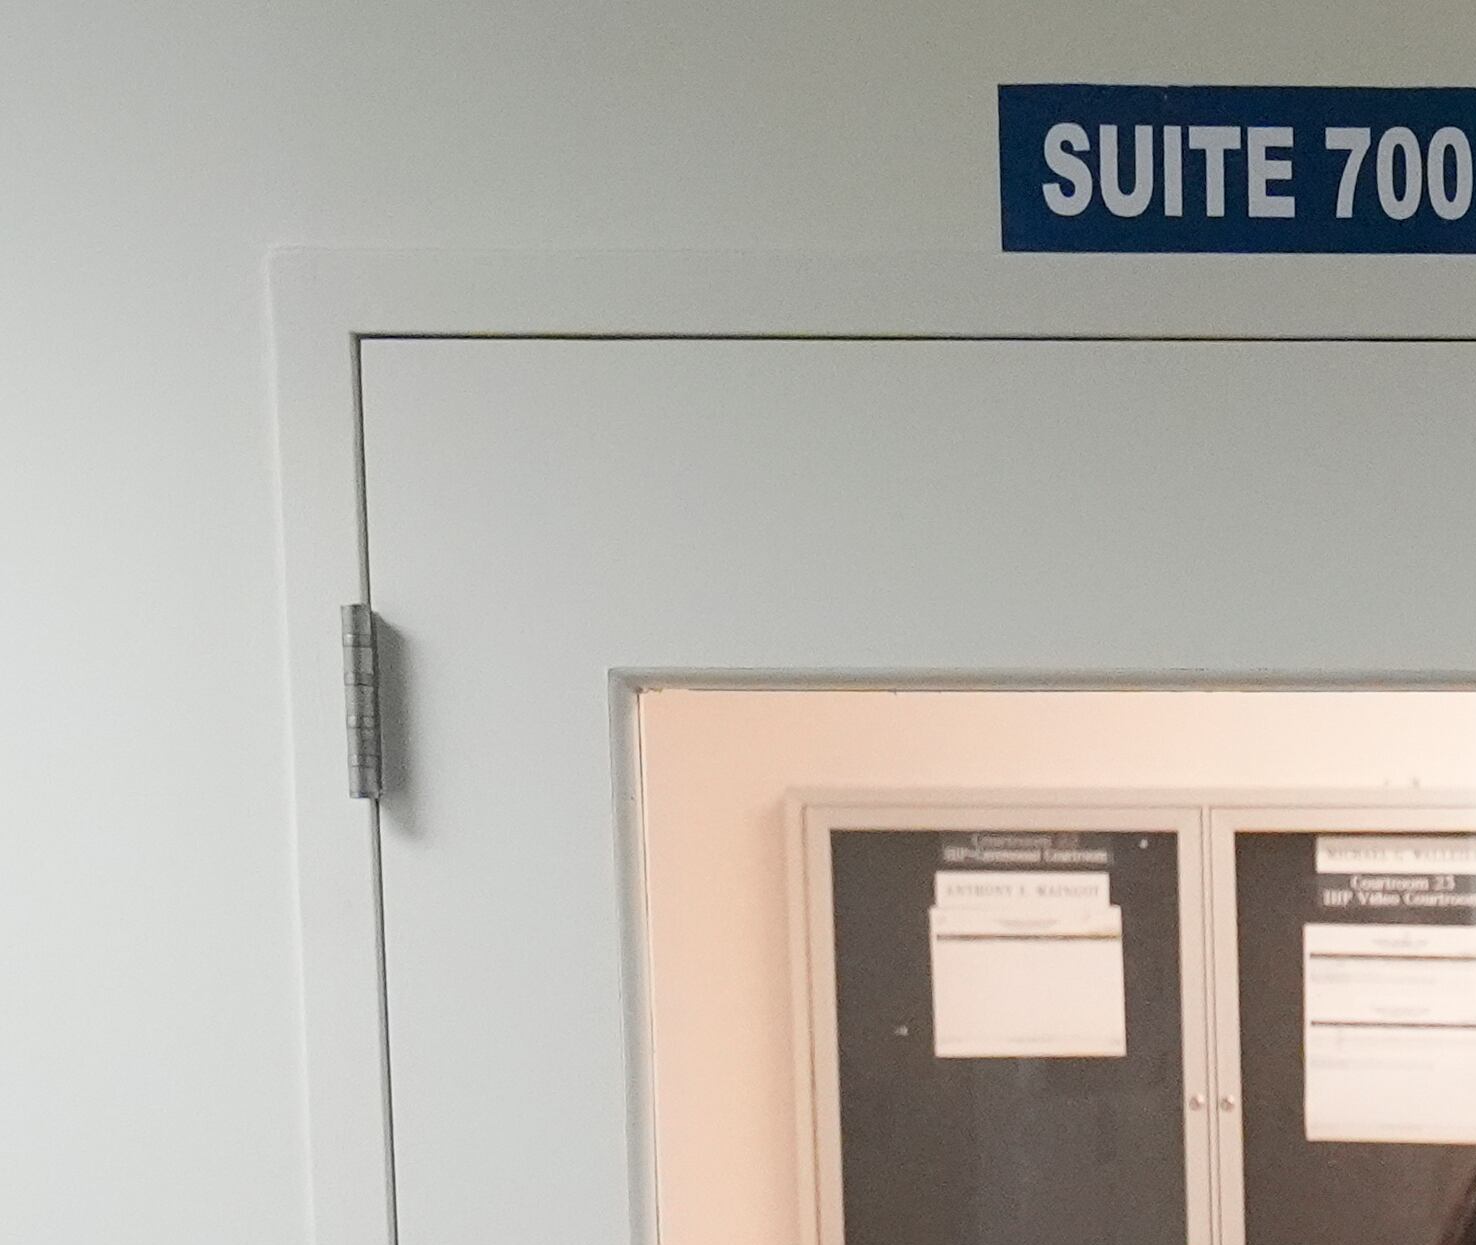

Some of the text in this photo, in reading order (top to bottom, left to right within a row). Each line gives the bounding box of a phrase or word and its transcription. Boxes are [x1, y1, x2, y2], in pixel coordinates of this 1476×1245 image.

[1042, 123, 1295, 218] SUITE
[1325, 126, 1473, 220] 700
[1351, 875, 1430, 891] Courtroom
